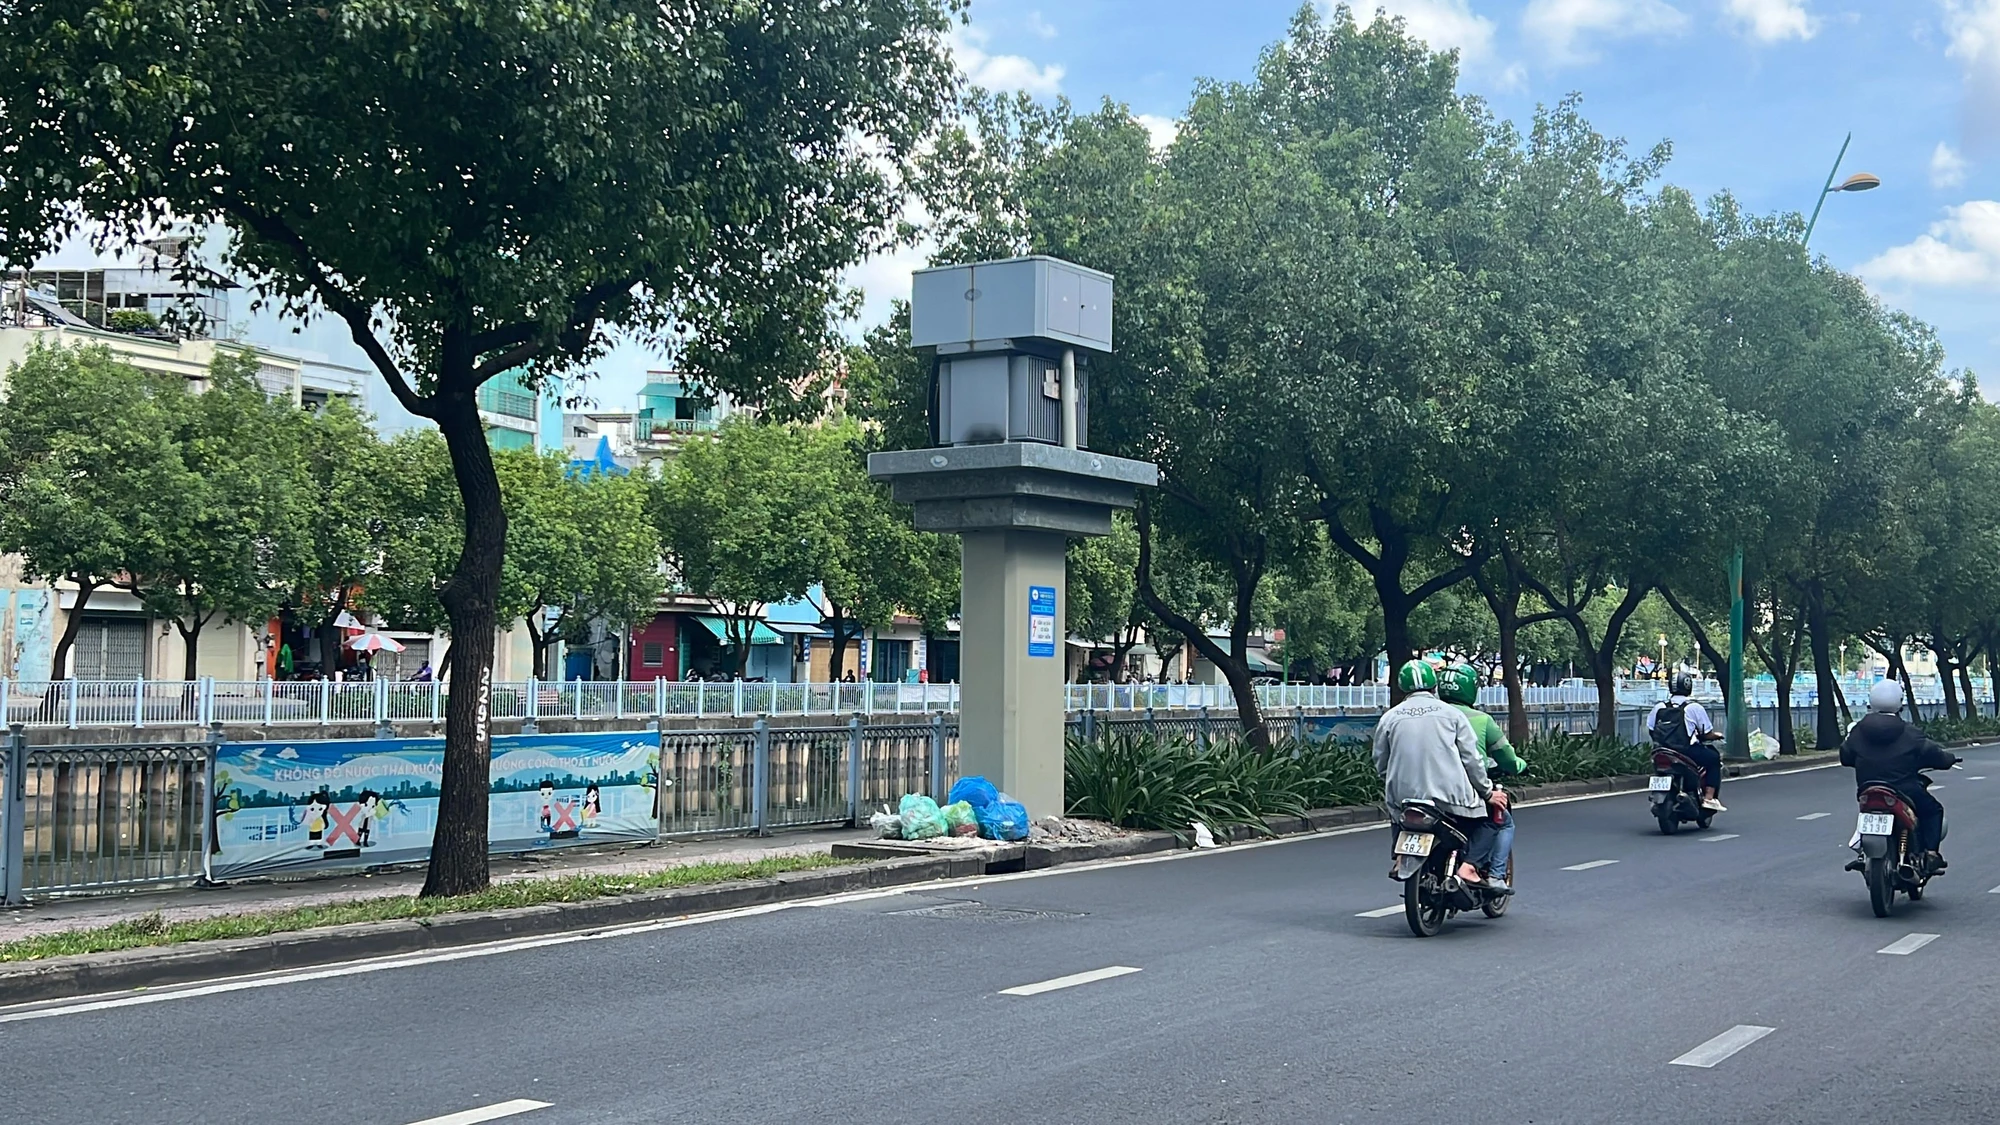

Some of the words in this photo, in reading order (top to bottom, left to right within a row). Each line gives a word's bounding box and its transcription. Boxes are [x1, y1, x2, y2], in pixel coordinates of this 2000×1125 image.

[1439, 681, 1459, 691] Grab
[476, 666, 490, 742] 2295
[558, 755, 589, 768] THOÁT
[274, 765, 321, 781] KHÔNG
[410, 758, 443, 775] XUỐN
[1862, 824, 1887, 833] 5130
